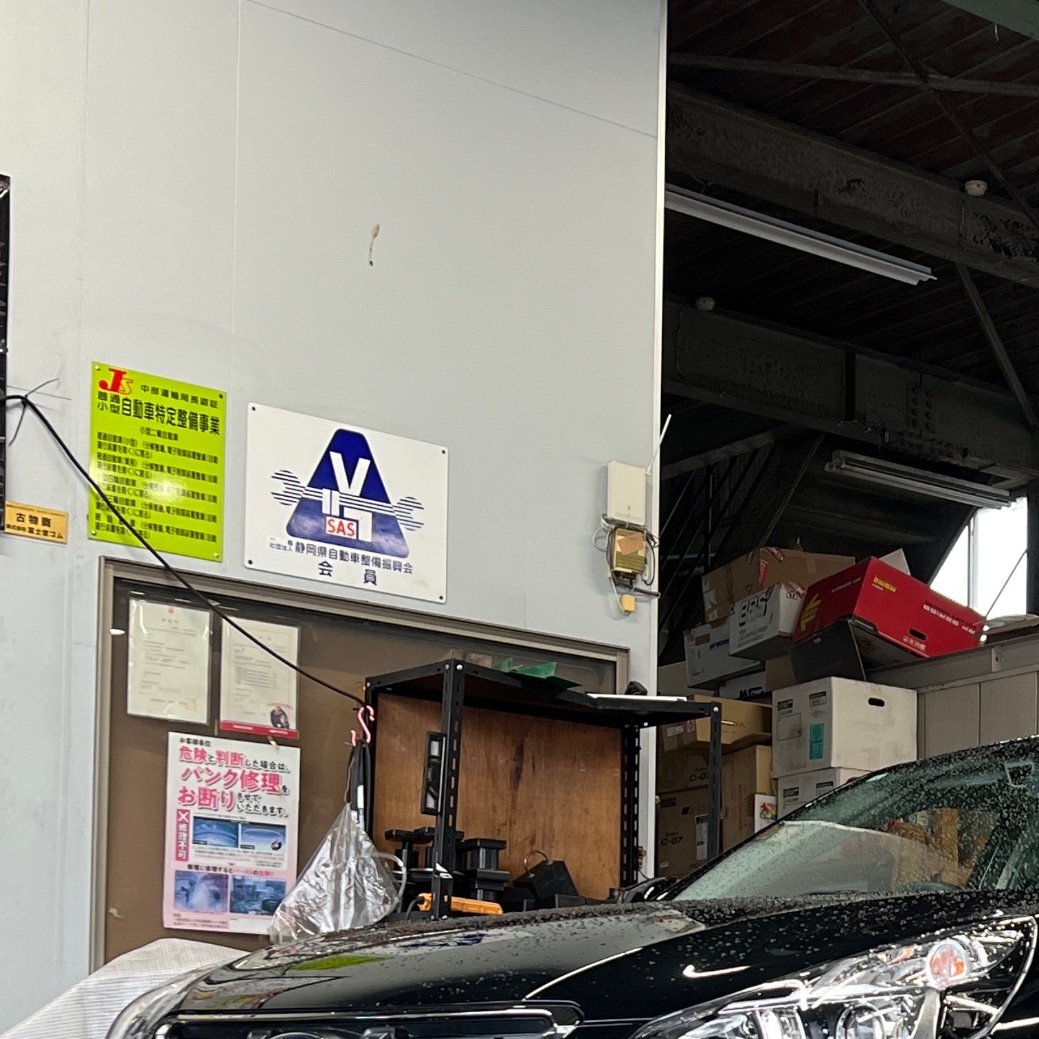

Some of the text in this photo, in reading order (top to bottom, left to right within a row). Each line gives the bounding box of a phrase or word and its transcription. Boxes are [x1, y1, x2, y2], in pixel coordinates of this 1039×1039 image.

[327, 518, 356, 537] SAS
[181, 767, 290, 796] パンク修理を
[178, 786, 235, 812] お断り
[660, 835, 684, 846] C-07
